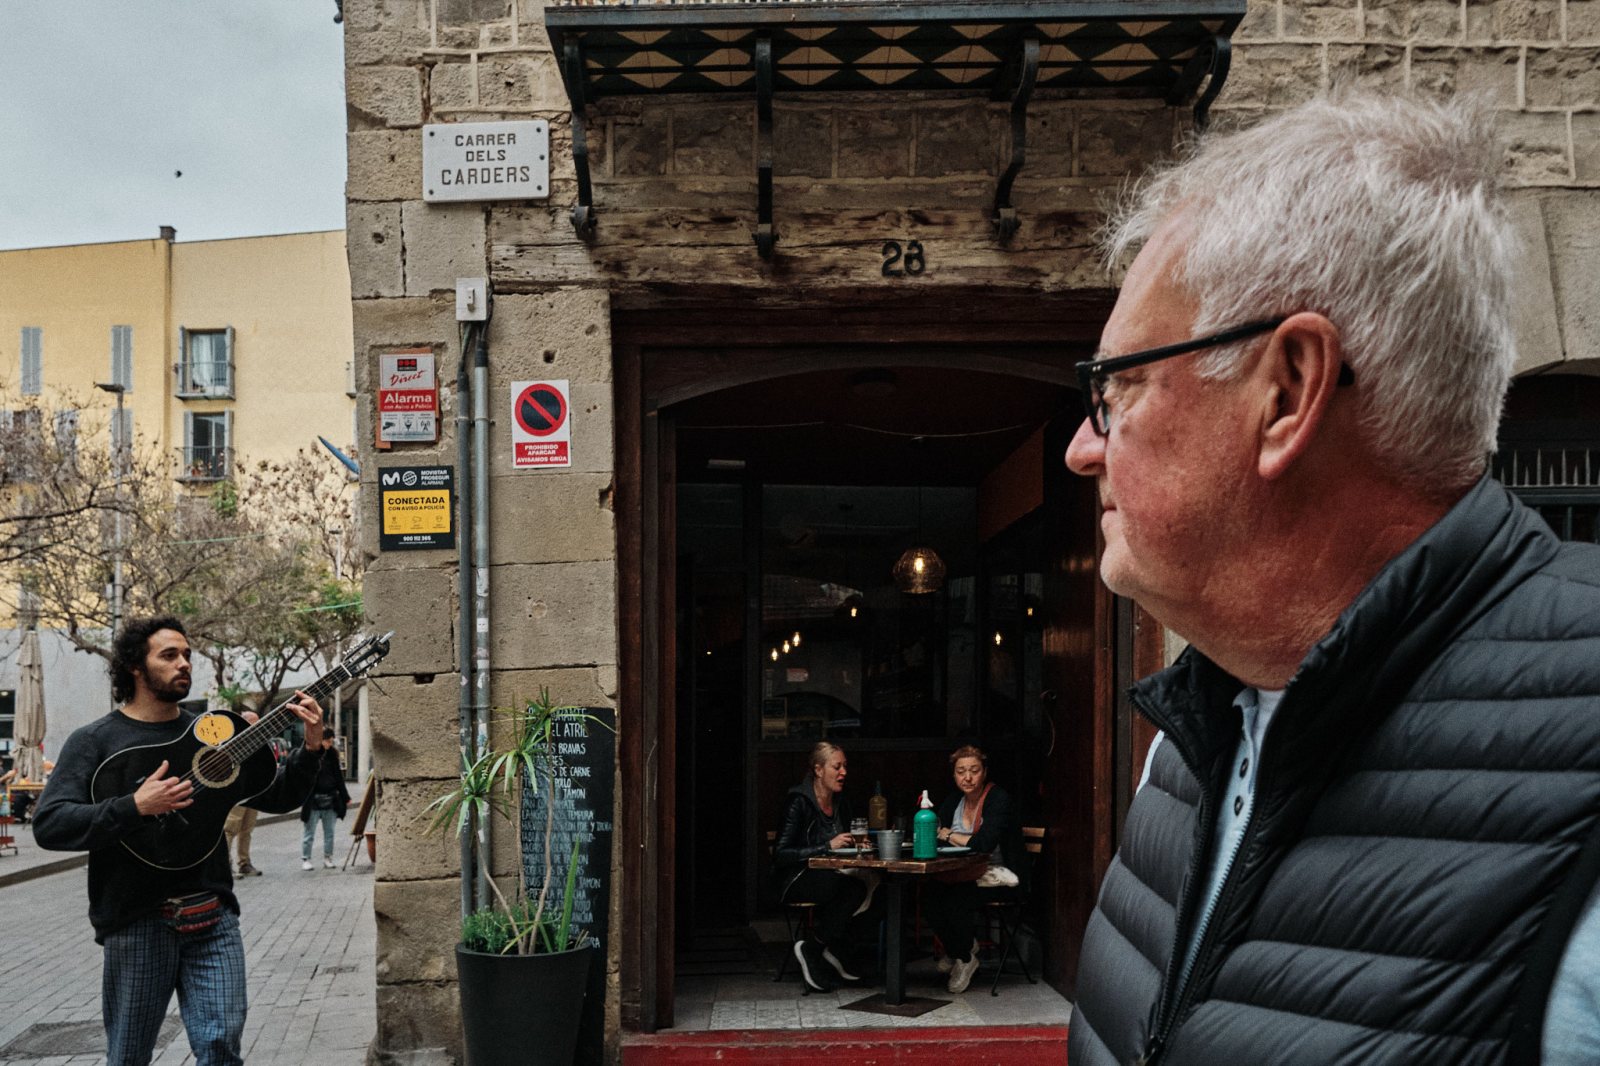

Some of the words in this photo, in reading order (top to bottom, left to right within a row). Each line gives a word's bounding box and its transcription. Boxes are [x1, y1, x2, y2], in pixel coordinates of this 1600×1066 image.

[455, 133, 516, 147] CARRER
[466, 149, 506, 162] DELS
[441, 166, 530, 185] CARDERS
[881, 240, 925, 277] 28
[384, 393, 432, 403] Alarma
[388, 497, 445, 505] CONECTADA
[563, 722, 588, 738] ATRIL
[558, 742, 586, 755] BRAVAS
[559, 766, 567, 777] DE
[570, 766, 591, 778] CARNE
[555, 778, 572, 789] POLLO
[557, 888, 586, 900] PLCHA
